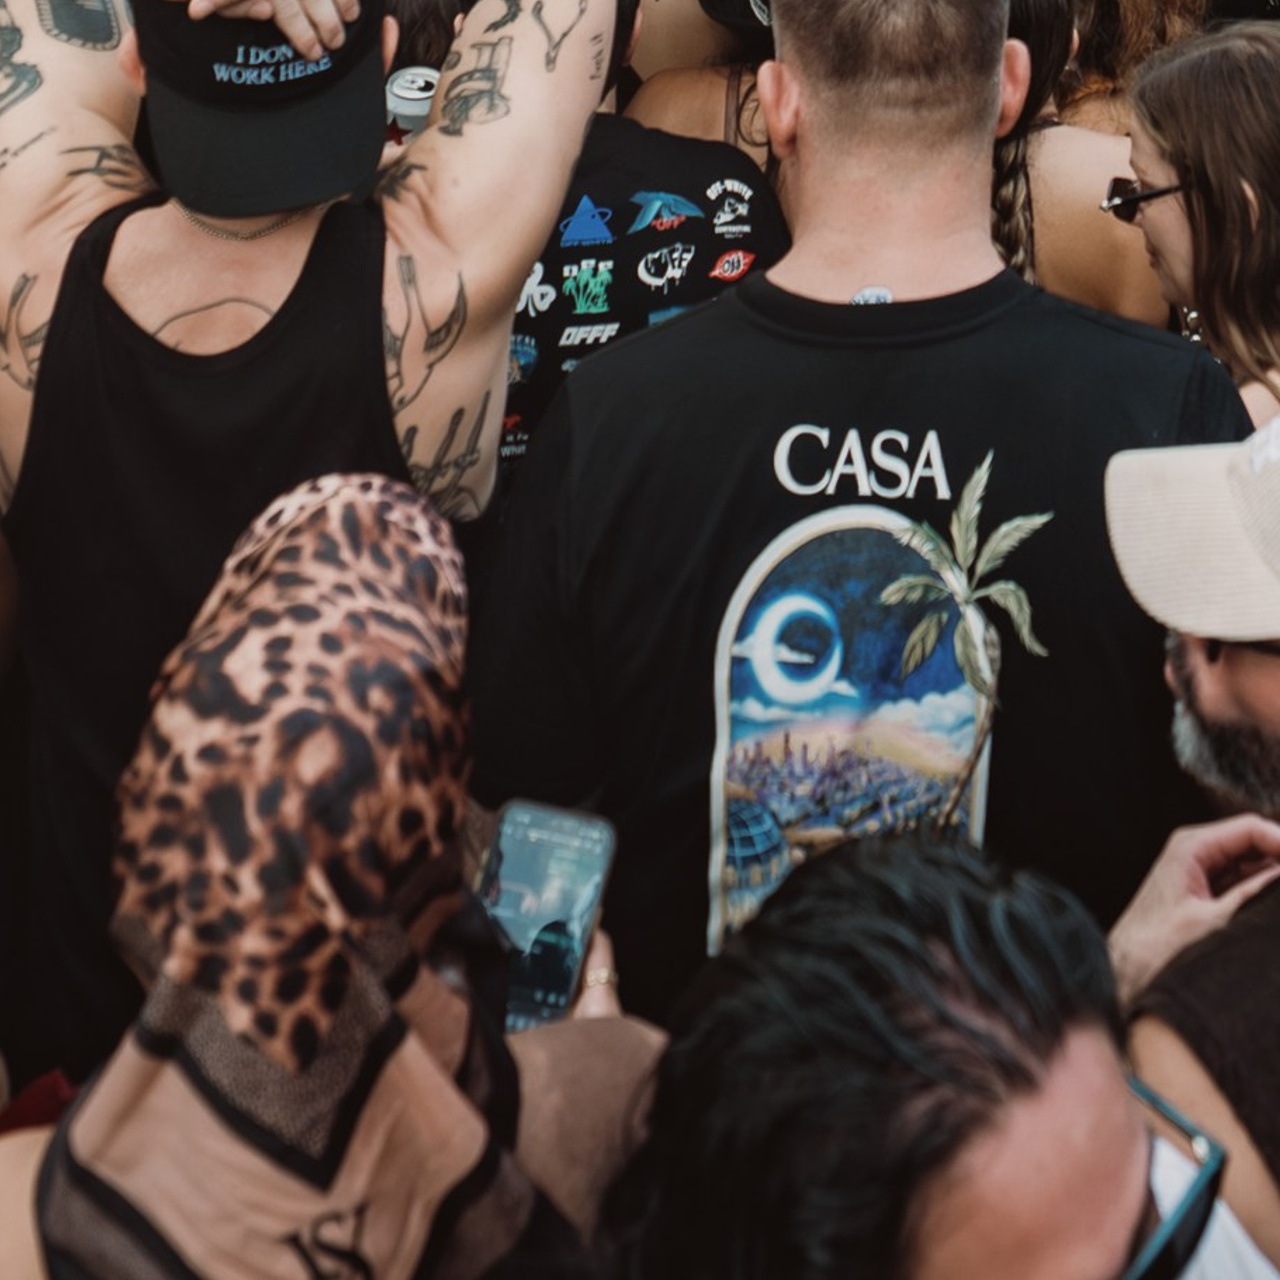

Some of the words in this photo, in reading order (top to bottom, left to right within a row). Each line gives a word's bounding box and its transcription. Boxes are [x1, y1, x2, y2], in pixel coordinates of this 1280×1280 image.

[236, 45, 246, 64] I
[249, 44, 294, 65] DON
[213, 61, 276, 85] WORK
[773, 424, 952, 500] CASA
